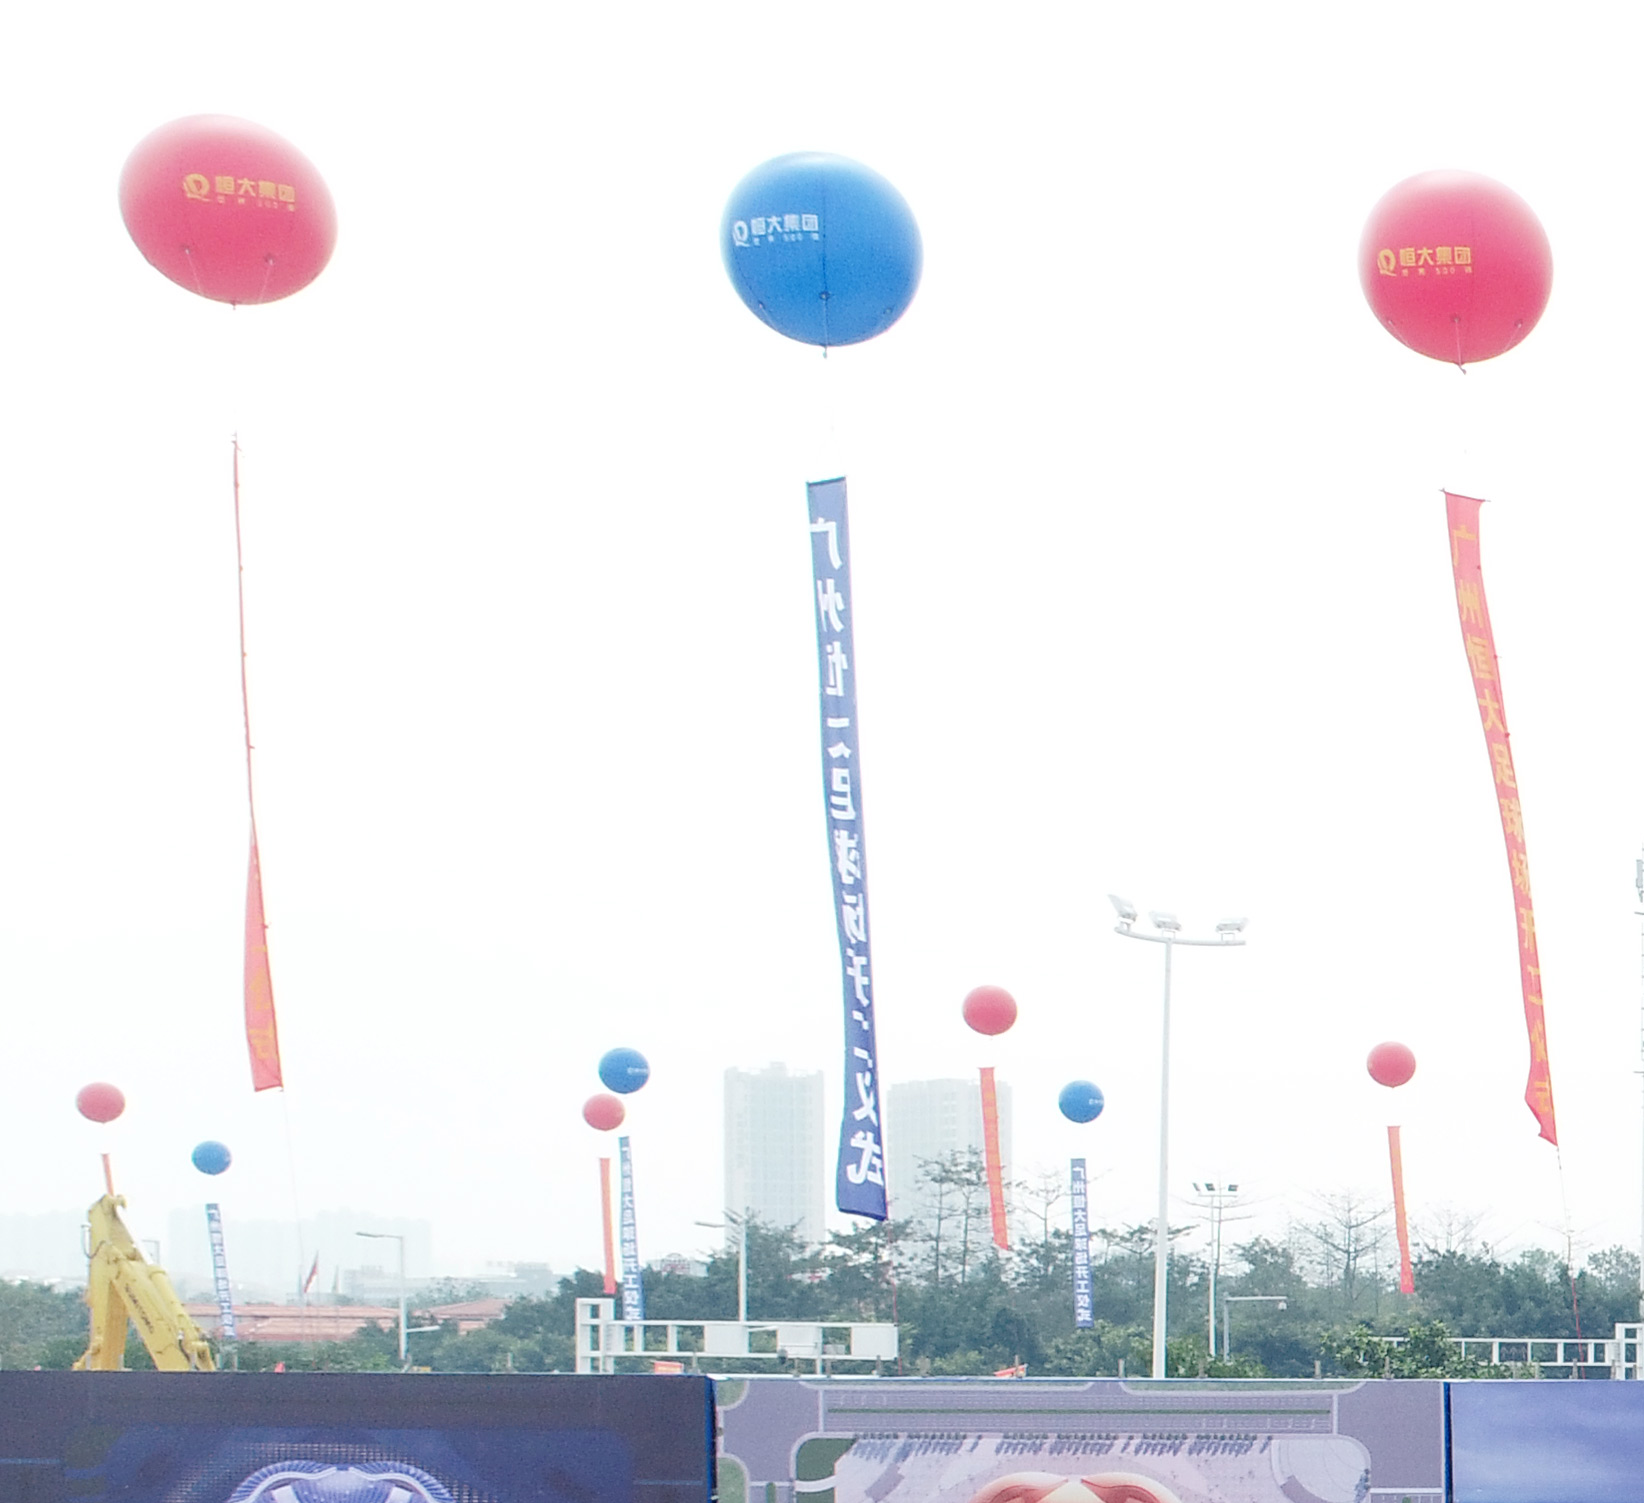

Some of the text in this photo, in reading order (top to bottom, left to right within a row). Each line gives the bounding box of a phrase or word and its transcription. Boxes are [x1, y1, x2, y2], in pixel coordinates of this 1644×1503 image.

[215, 176, 296, 203] 恒大集团
[750, 214, 819, 236] 恒大集团
[1399, 246, 1471, 266] 恒大集团
